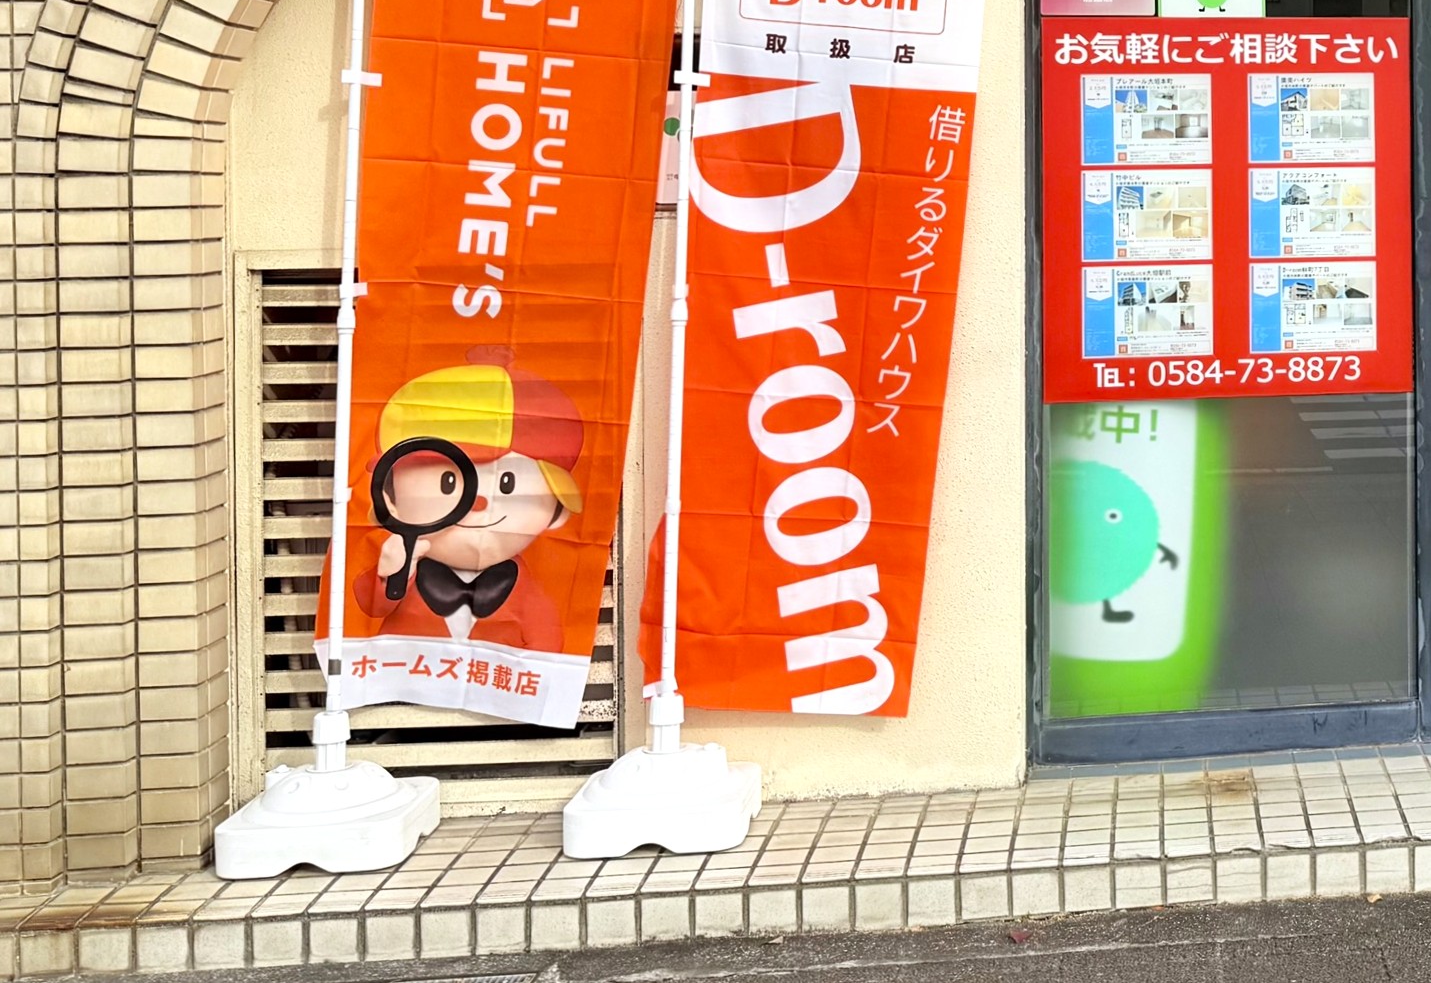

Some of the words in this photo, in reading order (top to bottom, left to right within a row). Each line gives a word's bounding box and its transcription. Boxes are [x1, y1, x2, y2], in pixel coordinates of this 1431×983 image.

[765, 34, 916, 64] 取扱店
[1054, 31, 1399, 65] お気軽にご相談下さい
[526, 56, 575, 227] LIFULL
[866, 104, 967, 437] 借りるダイワハウス
[1147, 355, 1362, 387] 0584-73-8873
[689, 80, 896, 716] D-room
[350, 654, 542, 697] ホームズ掲載店
